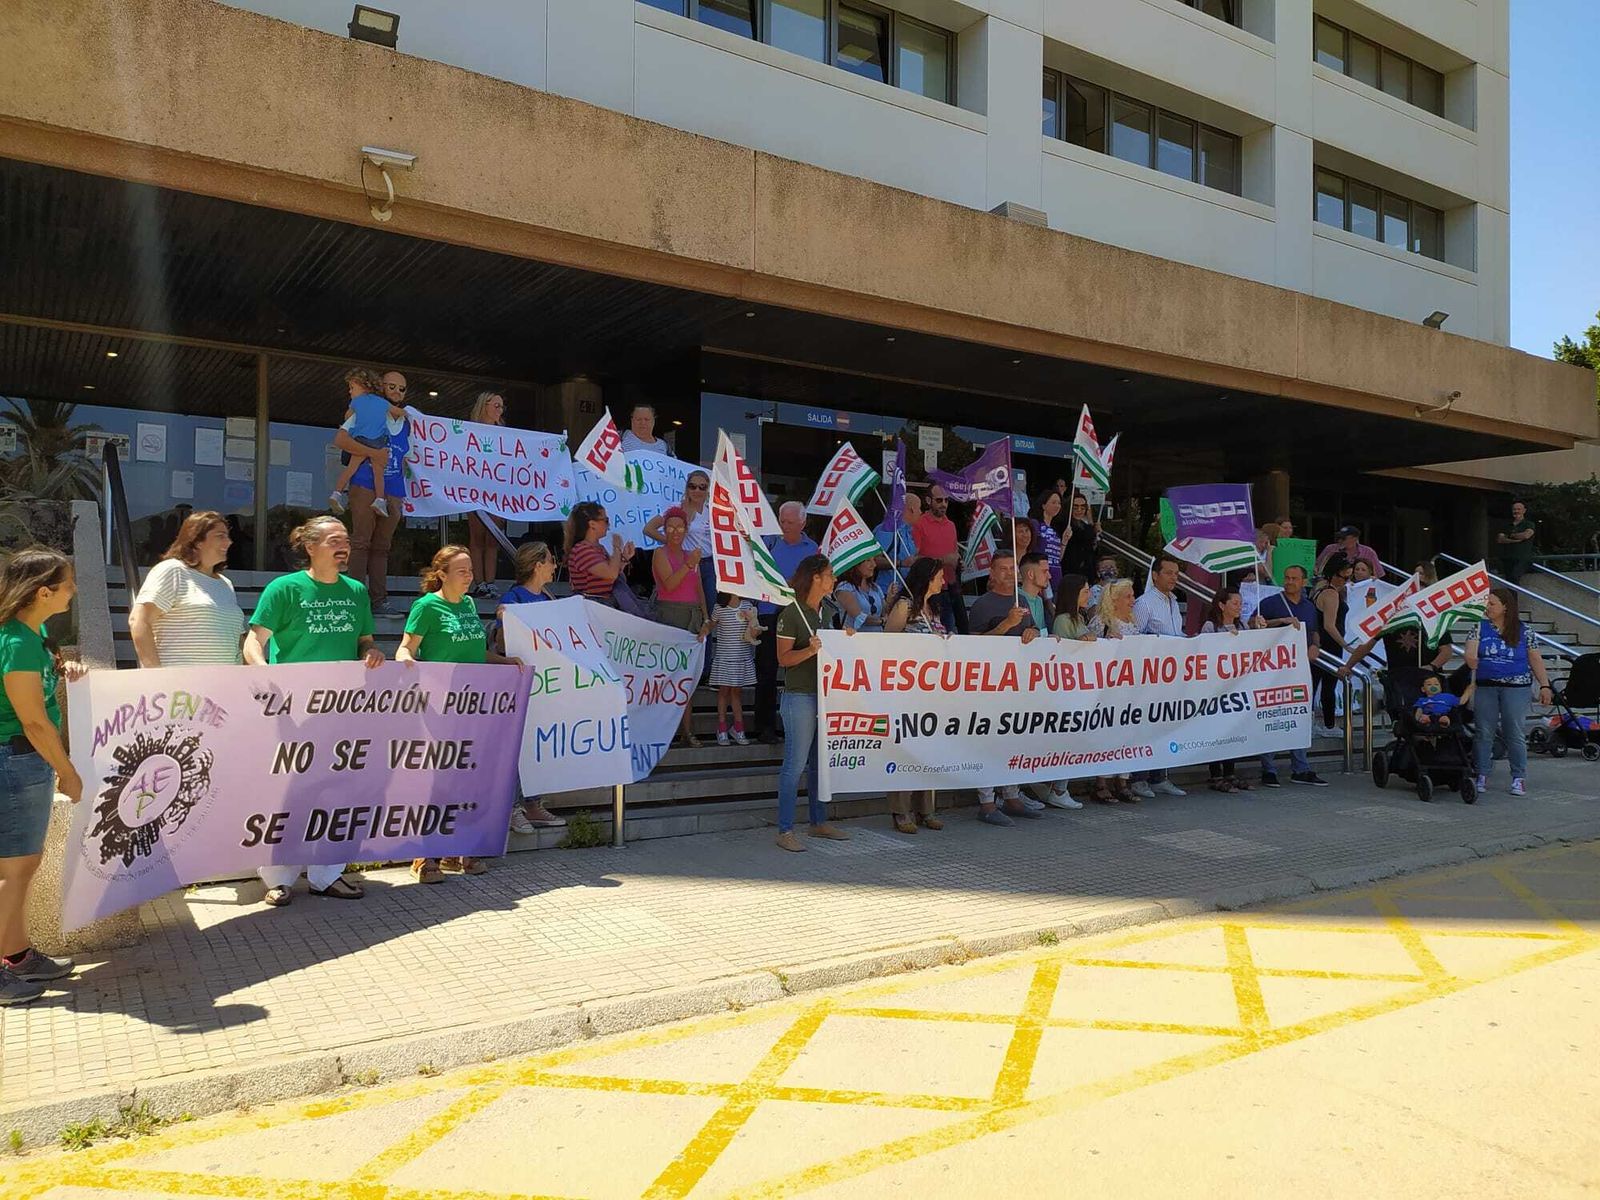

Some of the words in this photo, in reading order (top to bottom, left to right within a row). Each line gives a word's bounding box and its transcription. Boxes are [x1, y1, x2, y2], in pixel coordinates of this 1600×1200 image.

[807, 413, 832, 424] SALIDA
[413, 419, 447, 443] NO
[466, 432, 481, 452] A
[500, 437, 527, 459] LA
[407, 445, 546, 489] SEPARACIÓN
[410, 479, 433, 498] DE
[444, 485, 556, 513] HERMANOS
[568, 623, 587, 650] A
[529, 667, 561, 697] DE
[638, 674, 693, 706] AÑOS
[823, 659, 872, 697] ¡LA
[880, 660, 1019, 692] ESCUELA
[1029, 654, 1134, 692] PÚBLICA
[1141, 656, 1177, 685] NO
[1184, 655, 1208, 682] SE
[306, 683, 429, 714] EDUCACIÓN
[442, 685, 516, 715] PÚBLICA
[91, 692, 167, 757] AMPAS
[944, 717, 960, 735] a
[968, 712, 991, 735] la
[997, 703, 1115, 734] SUPRESIÓN
[1120, 703, 1142, 726] de
[272, 741, 315, 774] NO
[331, 739, 371, 771] SE
[389, 739, 478, 770] VENDE.
[896, 764, 921, 773] CCOO
[1008, 743, 1153, 773] #lapúblicanosecierra
[240, 812, 290, 848] SE
